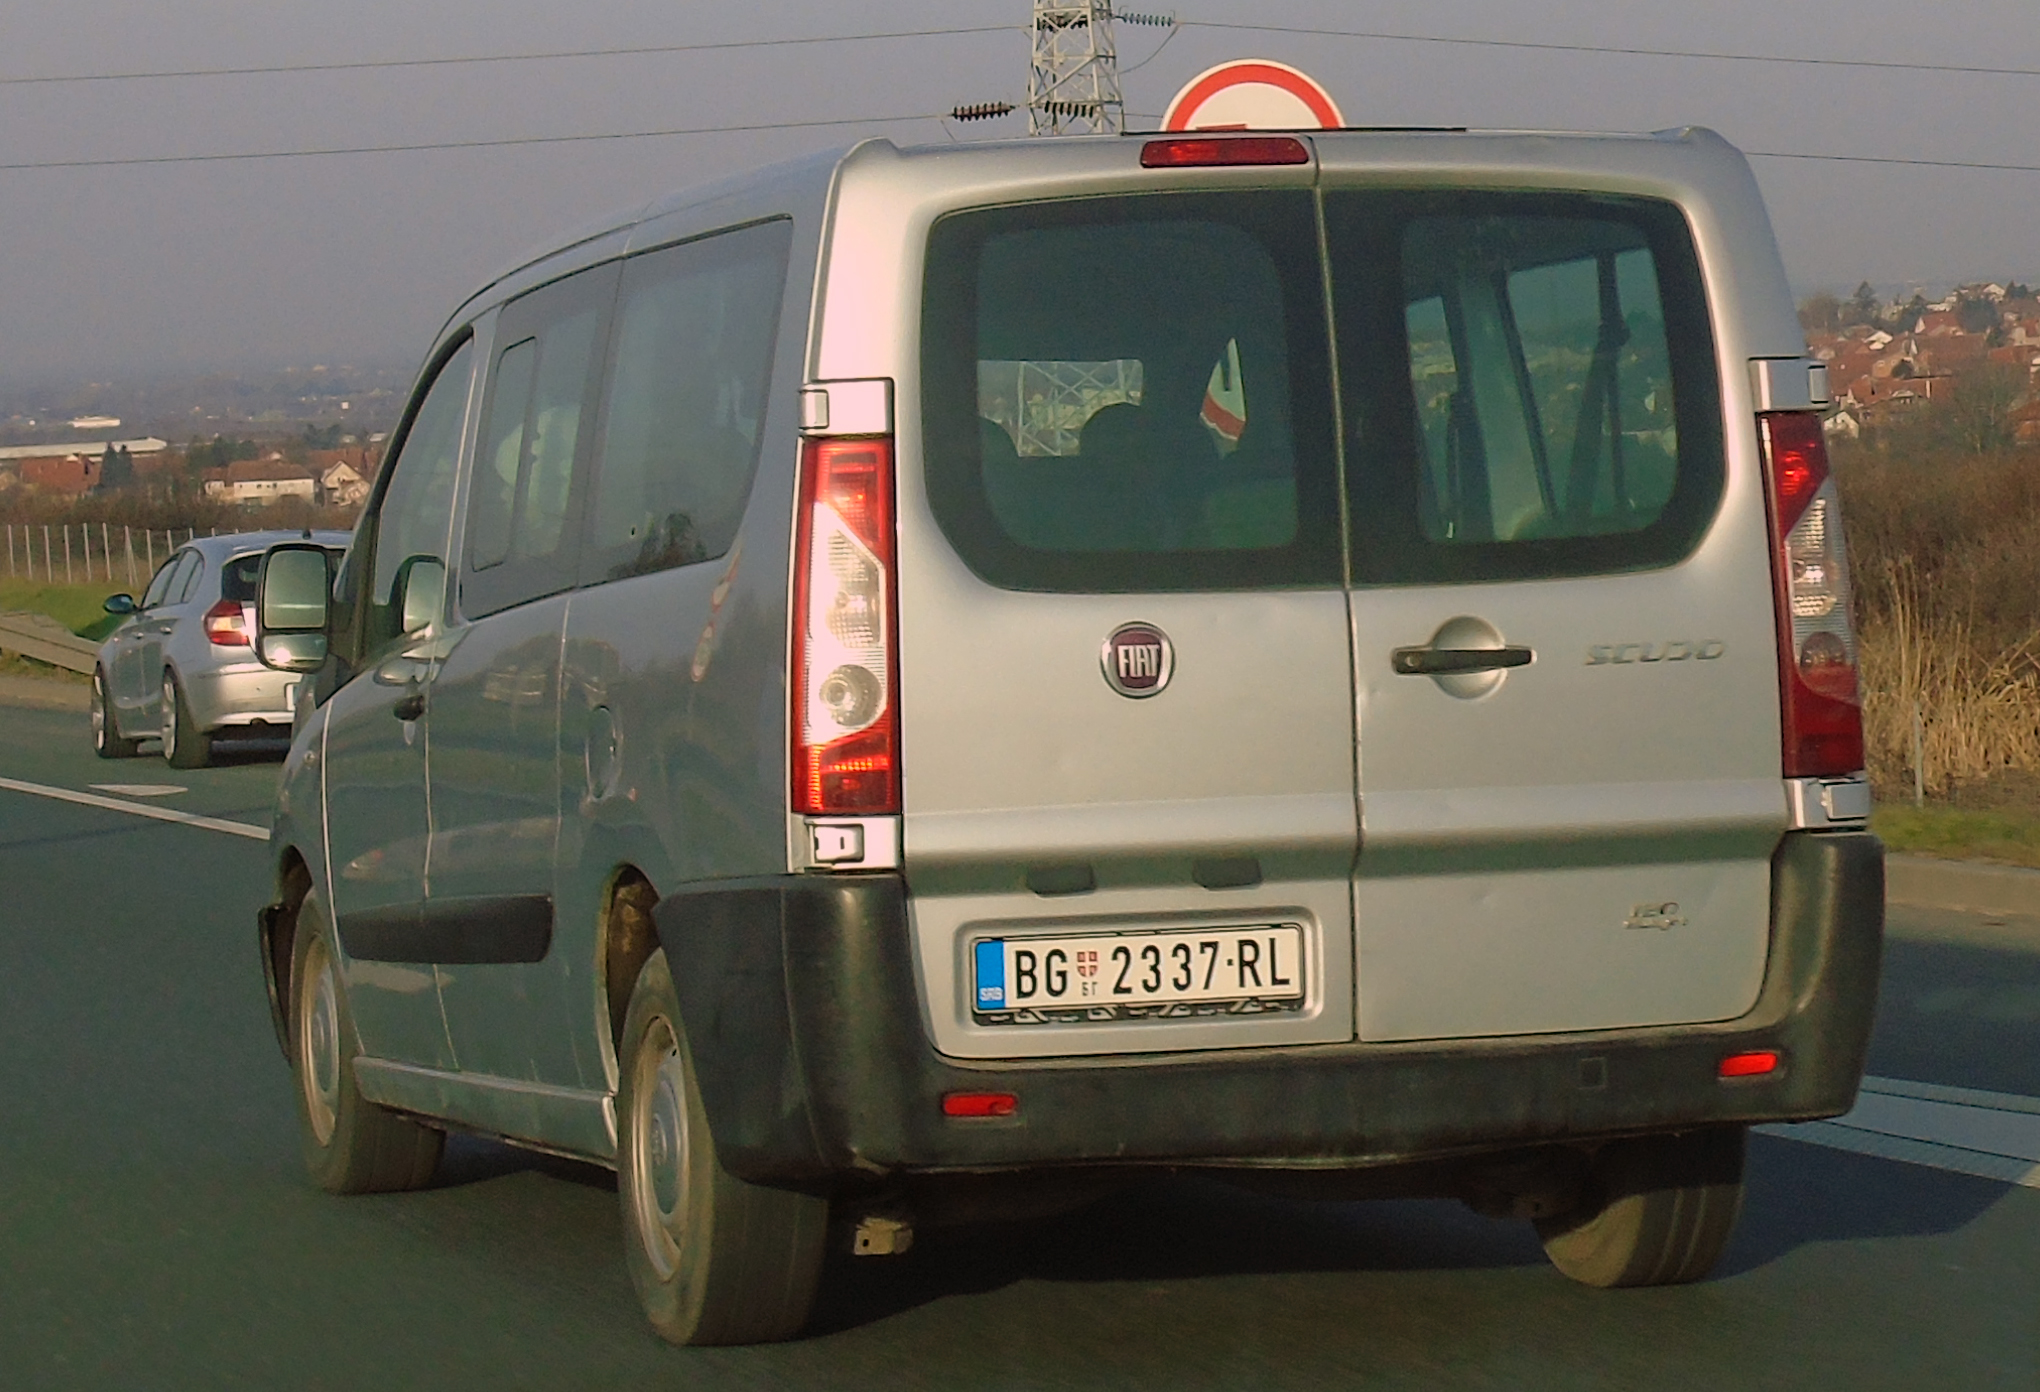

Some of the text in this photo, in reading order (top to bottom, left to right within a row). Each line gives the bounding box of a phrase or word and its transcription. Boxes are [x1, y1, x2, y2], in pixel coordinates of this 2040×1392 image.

[1117, 644, 1160, 678] FIAT
[1585, 638, 1726, 666] SCUDO
[1015, 949, 1068, 1000] BG
